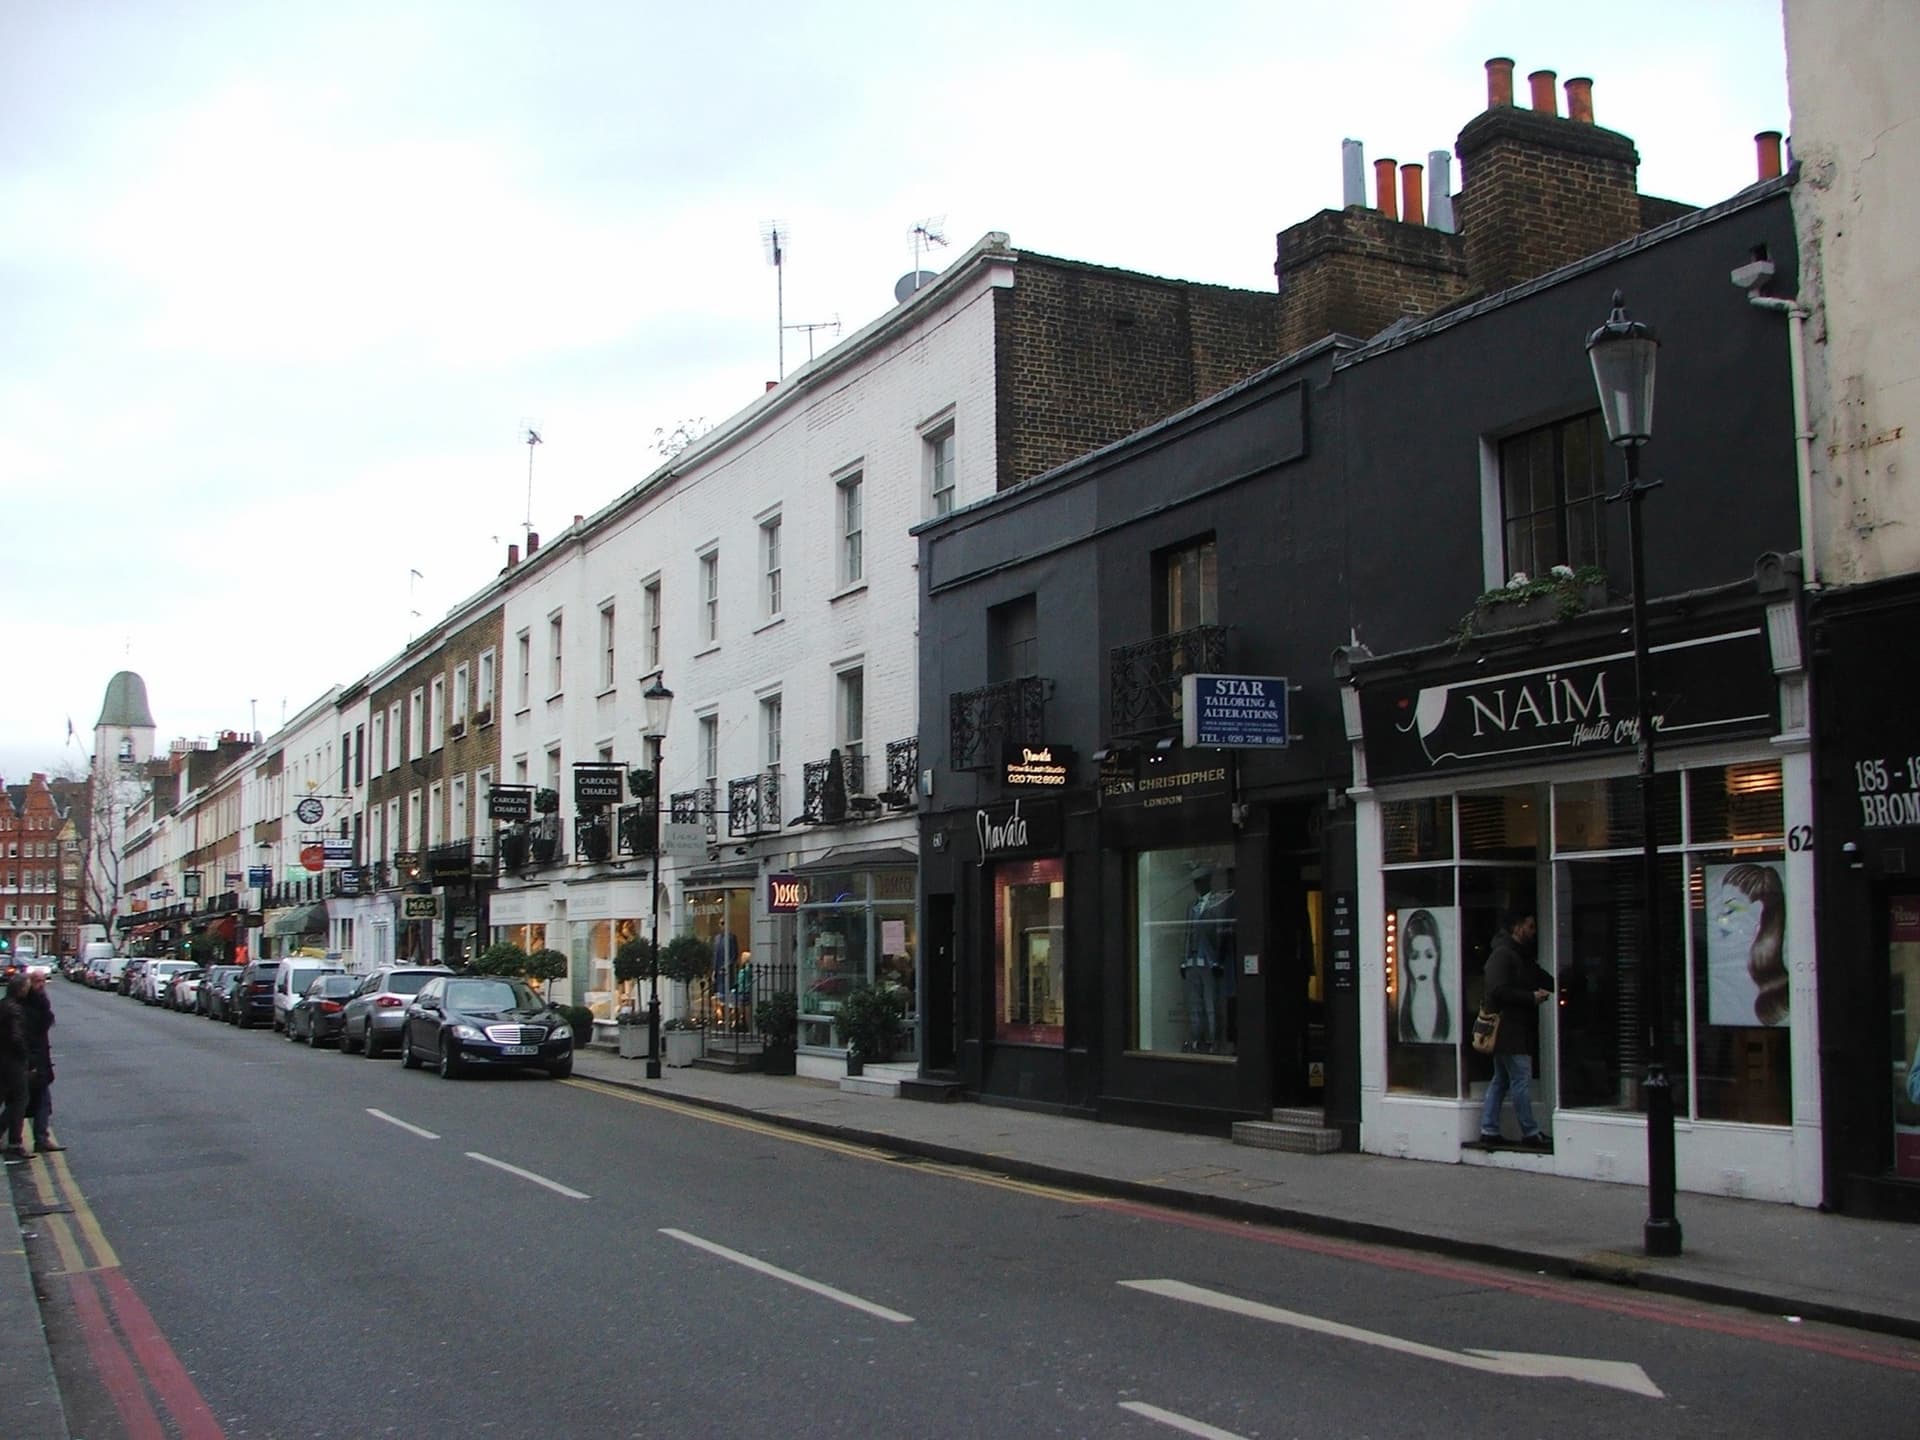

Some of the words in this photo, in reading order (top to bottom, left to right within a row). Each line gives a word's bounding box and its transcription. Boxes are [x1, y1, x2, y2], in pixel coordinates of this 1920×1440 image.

[1216, 680, 1264, 696] STAR
[1204, 696, 1265, 708] TAILORING
[1268, 699, 1276, 708] &
[1466, 672, 1611, 736] NAÏM
[1204, 708, 1278, 719] ALTERATIONS
[1572, 718, 1613, 747] Haute
[579, 777, 618, 785] CAROLINE
[1007, 774, 1025, 784] 020
[1139, 768, 1225, 791] CHRISTOPHER
[1855, 759, 1888, 792] 185
[581, 788, 618, 796] CHARLES
[492, 796, 528, 804] CAROLINE
[1143, 795, 1182, 807] LONDON
[494, 806, 527, 814] CHARLES
[1861, 791, 1920, 827] BROM
[976, 799, 1028, 868] Shavata
[1788, 825, 1813, 853] 62
[409, 902, 433, 911] MAP
